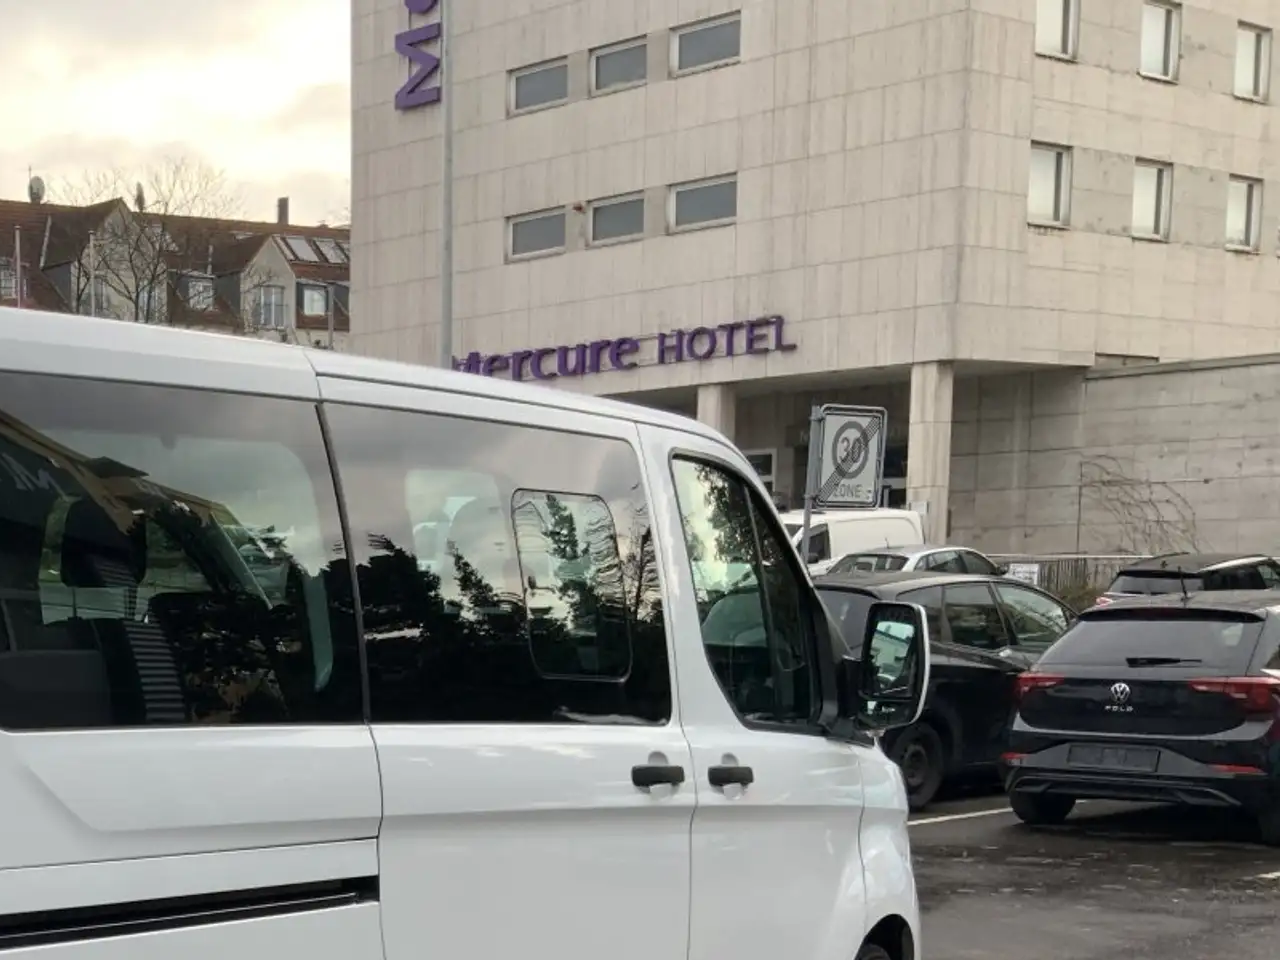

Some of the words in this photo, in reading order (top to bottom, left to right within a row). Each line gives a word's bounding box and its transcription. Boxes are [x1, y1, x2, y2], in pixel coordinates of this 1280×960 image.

[395, 0, 442, 112] M
[657, 315, 798, 365] HOTEL
[839, 436, 862, 463] 30
[833, 483, 864, 499] ZONE
